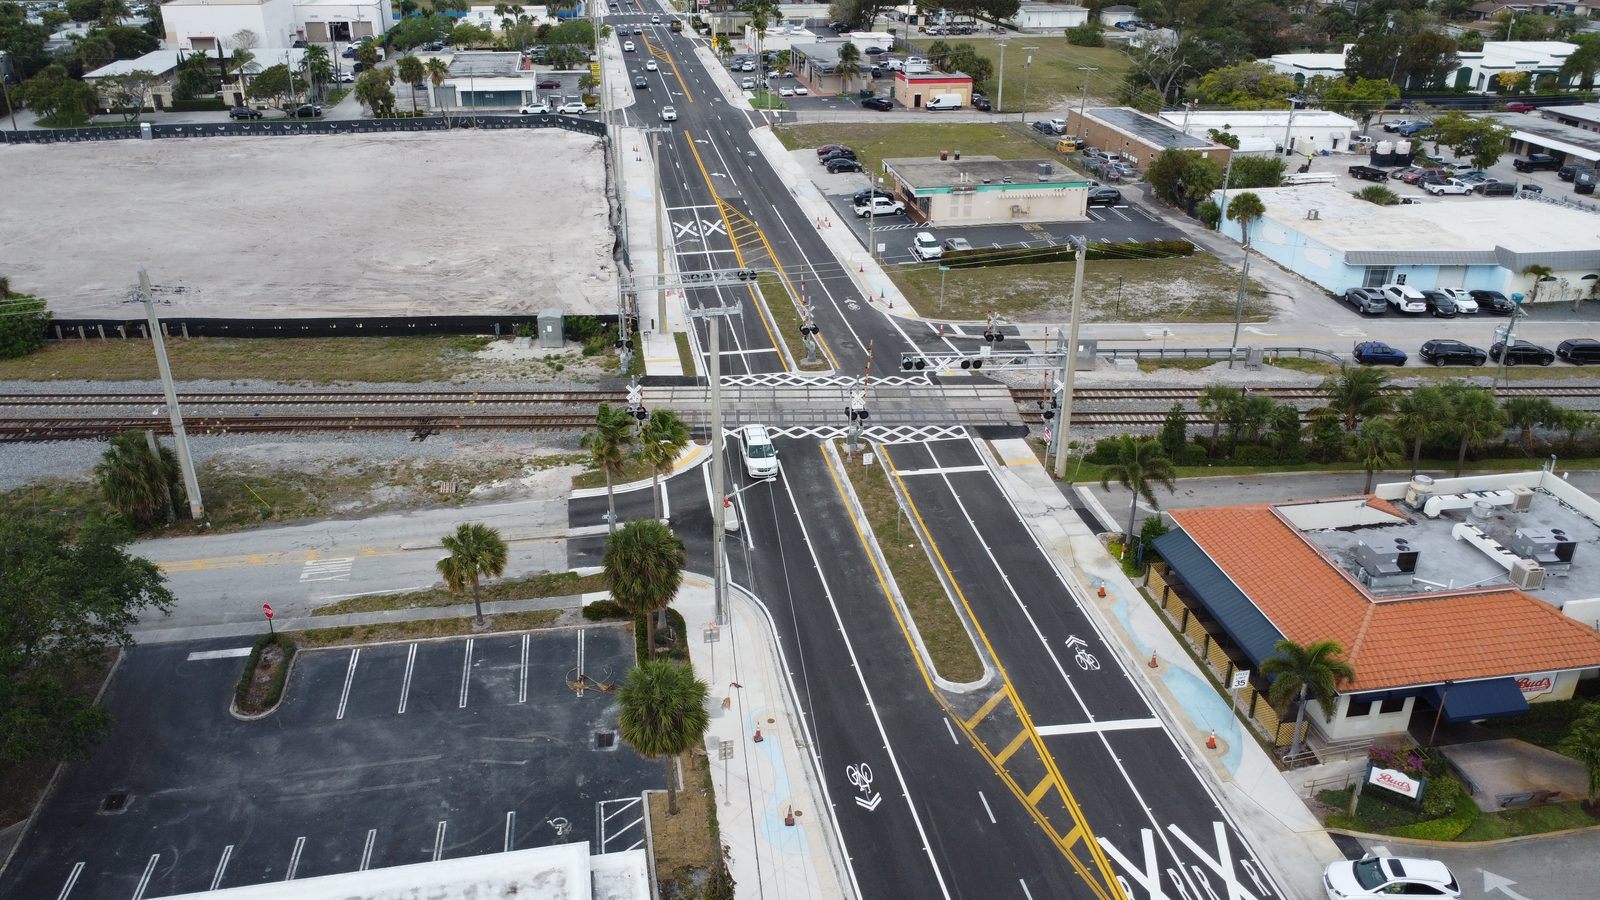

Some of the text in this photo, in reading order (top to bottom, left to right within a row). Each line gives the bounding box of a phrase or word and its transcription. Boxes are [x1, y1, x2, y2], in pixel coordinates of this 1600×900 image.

[1234, 679, 1246, 687] 35
[1515, 677, 1551, 690] Bud's
[1376, 773, 1411, 792] Bud's
